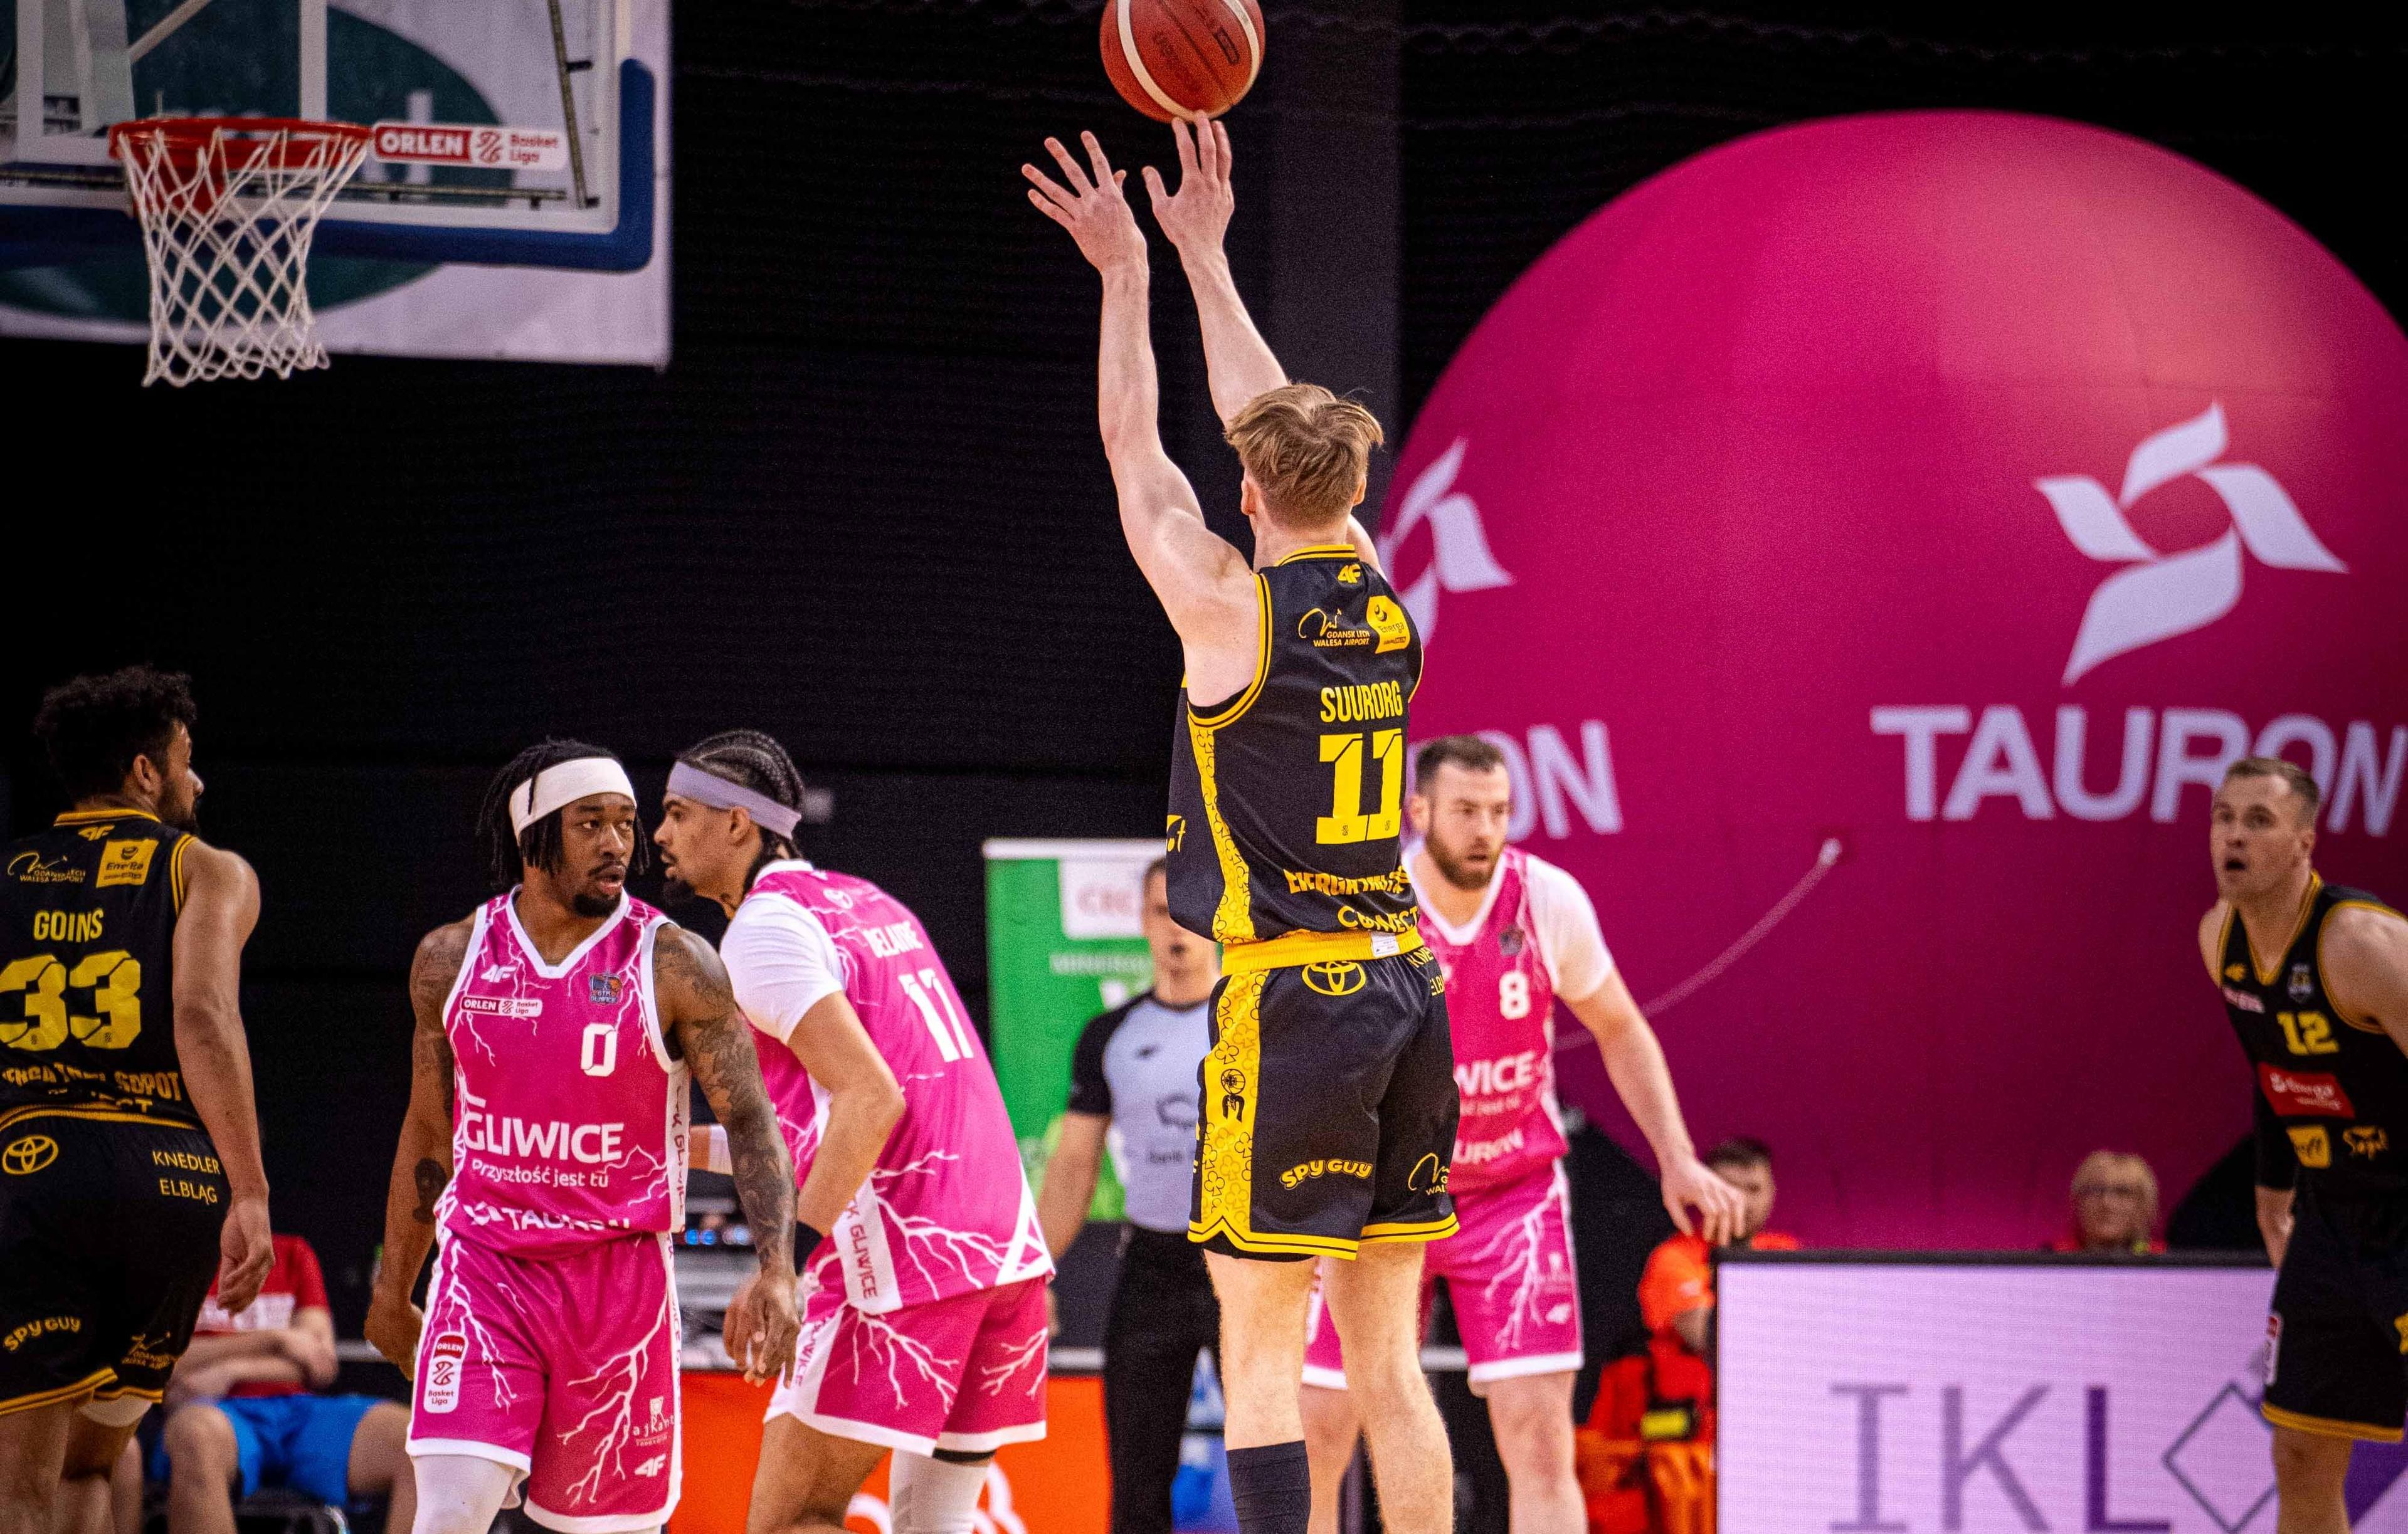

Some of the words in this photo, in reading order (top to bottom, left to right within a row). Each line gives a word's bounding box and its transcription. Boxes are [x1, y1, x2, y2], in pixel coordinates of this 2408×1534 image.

[381, 132, 464, 155] ORLEN
[510, 134, 558, 148] Basket
[510, 150, 540, 164] Liga
[1314, 639, 1343, 647] WALESA
[1326, 631, 1355, 639] GDANSK
[1320, 680, 1403, 722] SUURORG
[1869, 703, 2408, 838] TAURON
[1316, 728, 1402, 844] 11
[34, 908, 103, 942] GOINS
[480, 964, 517, 983] 4F
[0, 950, 141, 1051] 33
[463, 999, 497, 1011] ORLEN
[1499, 970, 1530, 1020] 8
[2276, 1011, 2340, 1056] 12
[581, 1022, 618, 1078] 0
[463, 1111, 625, 1164] GLIWICE
[152, 1150, 221, 1175] KNEDLER
[472, 1158, 551, 1184] Przyszłość
[553, 1168, 586, 1188] jest
[589, 1170, 609, 1188] tu
[850, 1224, 878, 1300] GLIWICE
[437, 1343, 464, 1352] ORLEN
[431, 1397, 448, 1406] Liga
[634, 1453, 667, 1478] 4F
